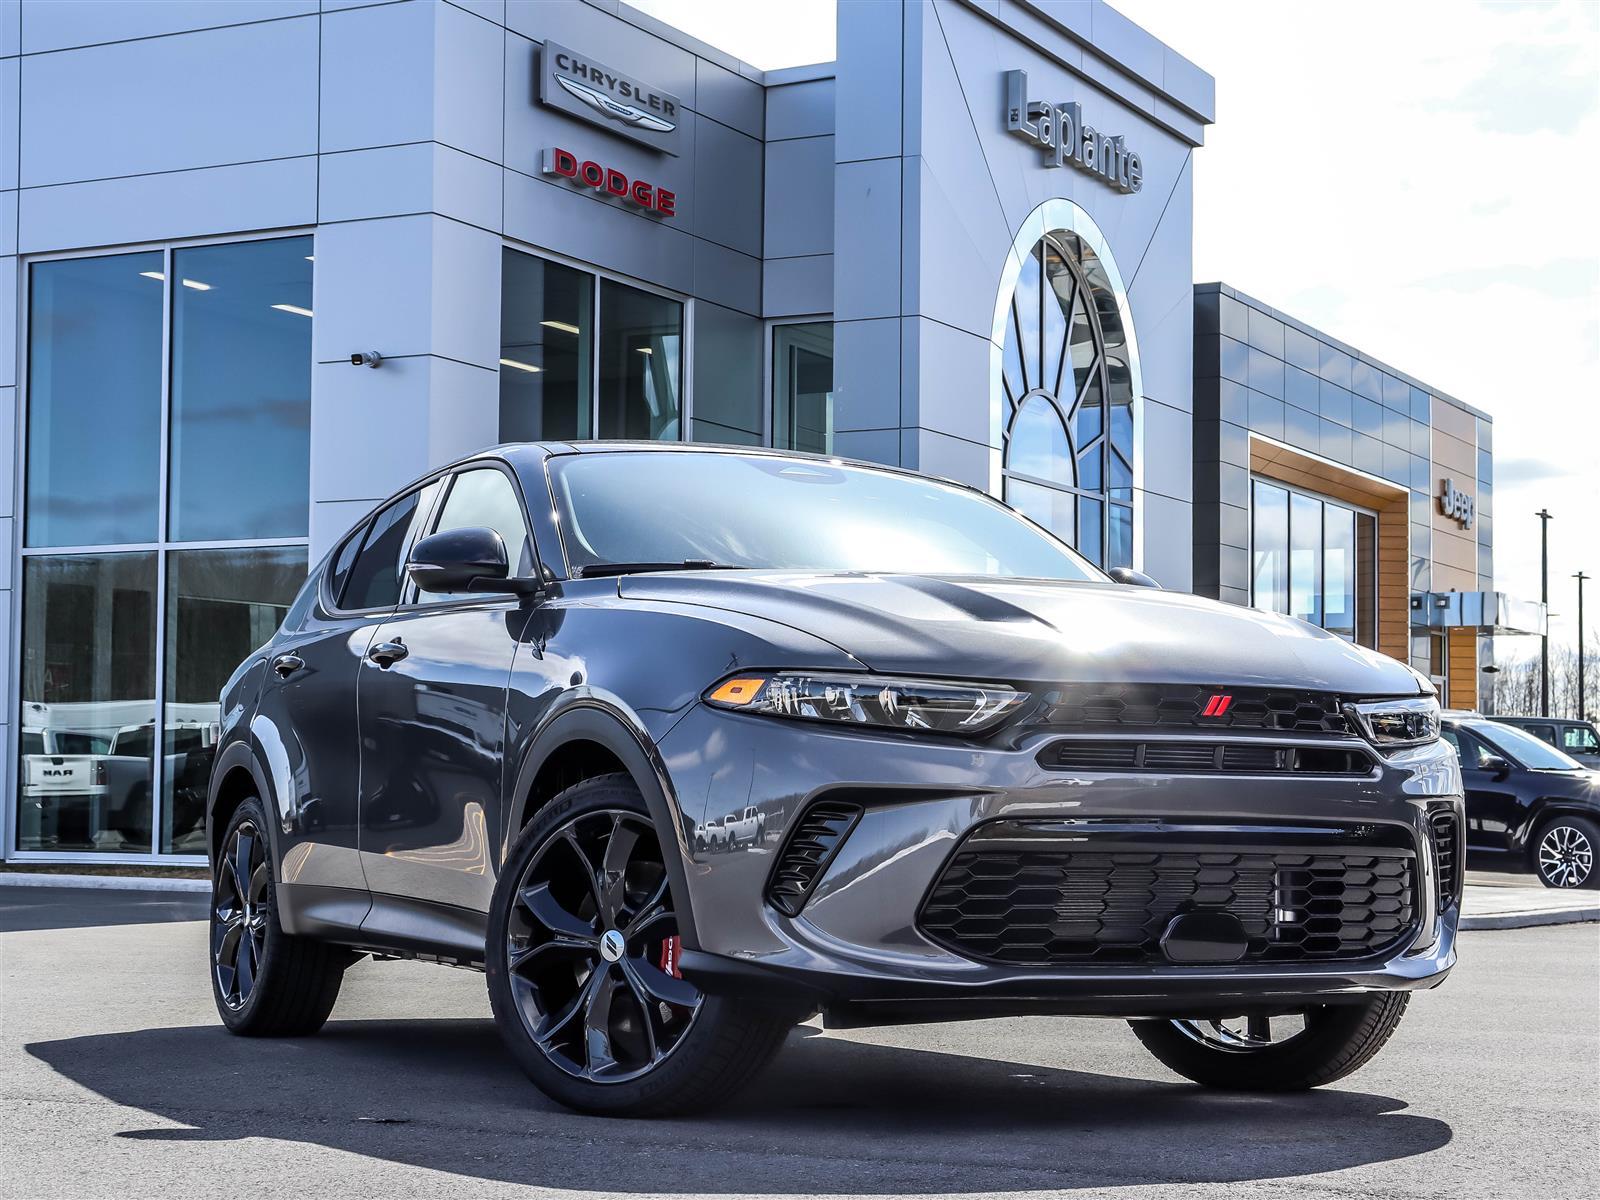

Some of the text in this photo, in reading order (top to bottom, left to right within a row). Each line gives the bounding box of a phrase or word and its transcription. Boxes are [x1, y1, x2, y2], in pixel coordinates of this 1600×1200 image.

[555, 53, 675, 117] CHRYSLER
[1009, 69, 1144, 193] Laplante
[553, 146, 676, 218] DODGE
[1442, 478, 1473, 530] Jeep
